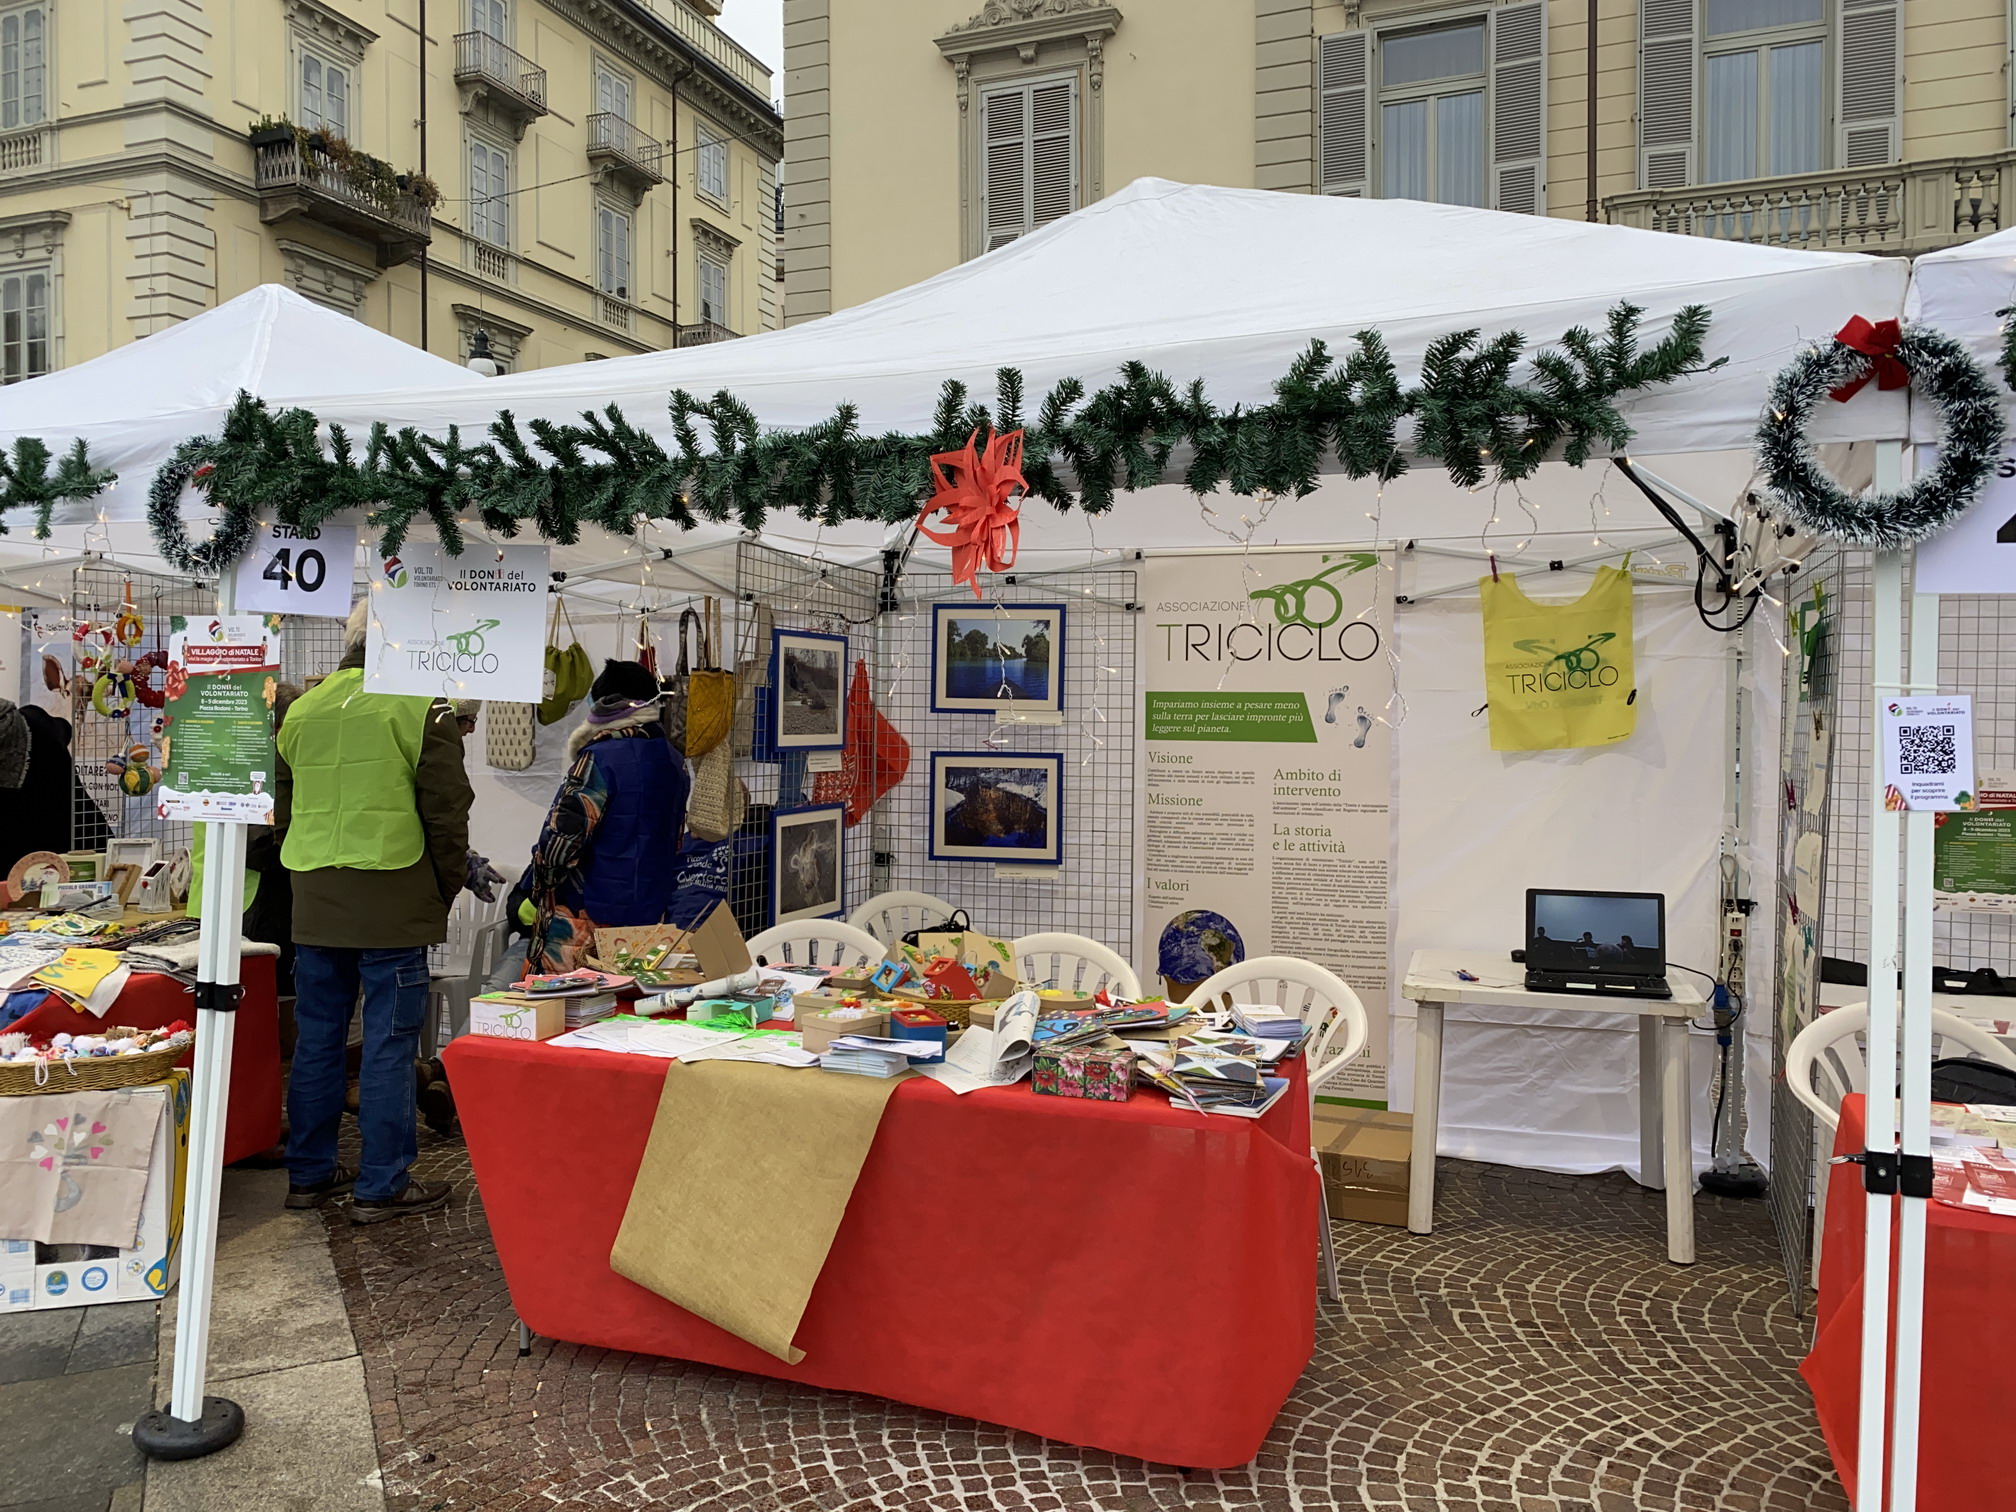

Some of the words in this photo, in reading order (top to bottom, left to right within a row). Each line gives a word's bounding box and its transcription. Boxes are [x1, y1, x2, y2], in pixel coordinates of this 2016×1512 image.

[263, 548, 326, 592] 40
[508, 571, 523, 579] del
[448, 582, 536, 592] VOLONTARIATO
[1156, 601, 1245, 612] ASSOCIAZIONE
[1156, 622, 1379, 661] TRICICLO
[407, 651, 498, 673] TRICICLO
[1506, 666, 1618, 694] TRICICLO
[1153, 700, 1198, 709] Impariamo
[1201, 700, 1234, 708] insieme
[1153, 712, 1171, 720] sulla
[1196, 714, 1209, 722] per
[1211, 713, 1244, 721] lasciare
[1247, 713, 1286, 722] impronte
[1288, 713, 1303, 723] più
[1153, 724, 1181, 734] leggere
[1183, 724, 1195, 732] sul
[1197, 725, 1232, 734] pianeta.
[1149, 752, 1193, 763] Visione
[1273, 768, 1323, 782] Ambito
[1328, 769, 1341, 782] di
[1273, 784, 1341, 797] intervento
[1148, 793, 1203, 806] Missione
[1273, 823, 1290, 835] La
[1295, 825, 1331, 837] storia
[1273, 842, 1280, 850] e
[1284, 839, 1295, 851] le
[1300, 840, 1345, 853] attività
[1147, 877, 1150, 888] I
[1155, 879, 1189, 891] valori
[476, 1022, 531, 1040] TRICICLO
